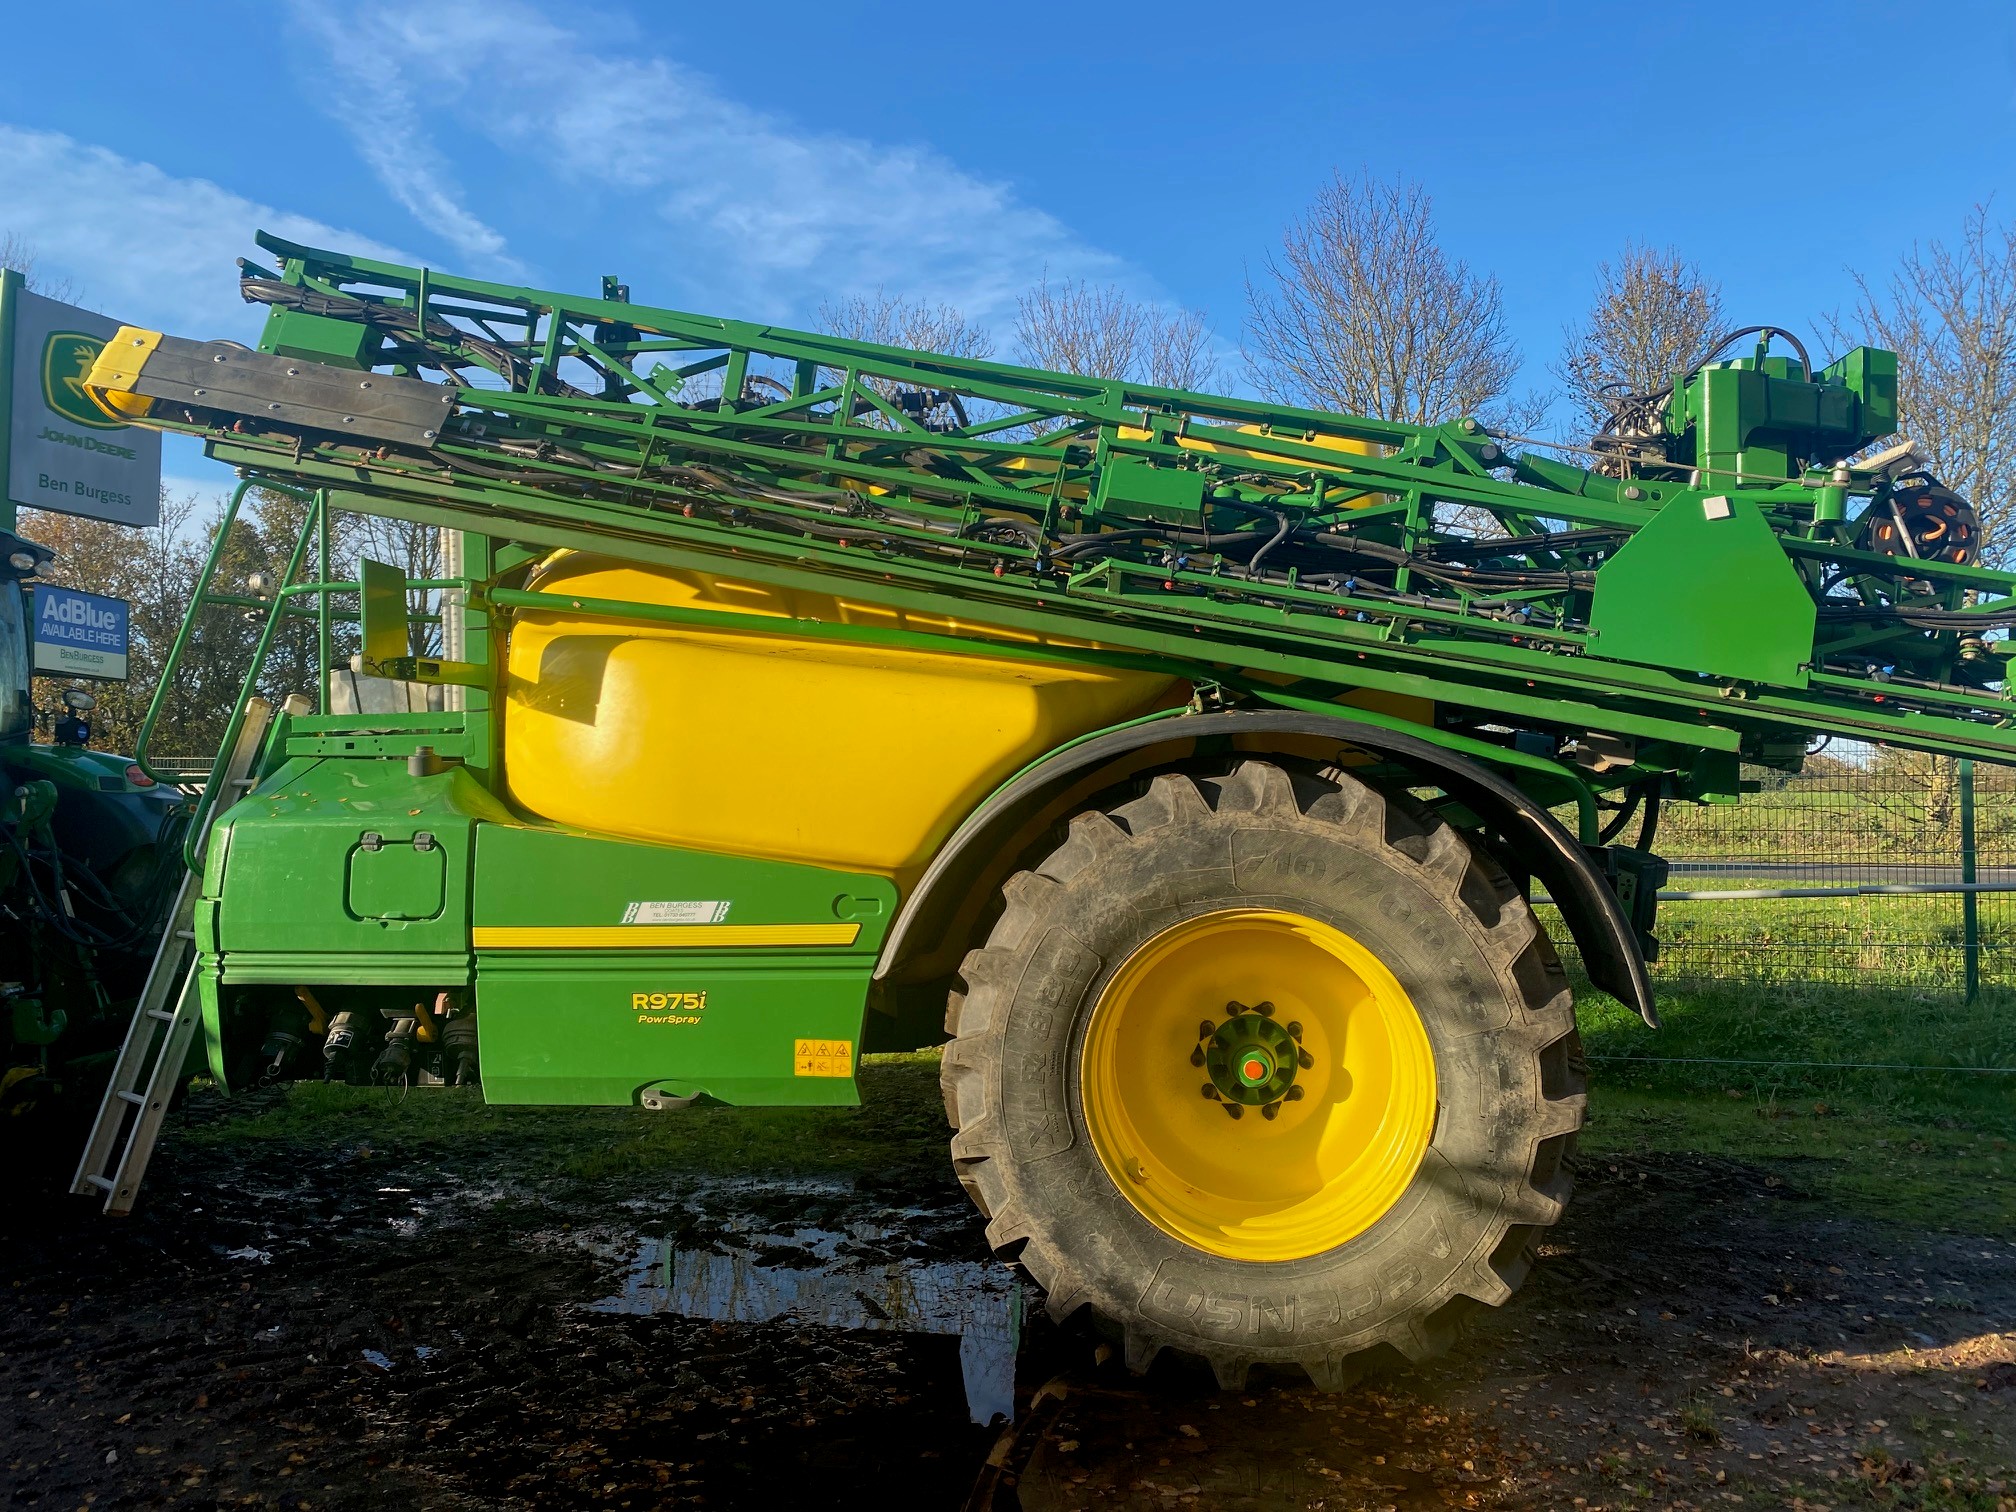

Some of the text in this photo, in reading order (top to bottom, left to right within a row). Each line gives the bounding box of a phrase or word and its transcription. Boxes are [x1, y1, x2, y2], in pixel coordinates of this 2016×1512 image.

[37, 426, 137, 461] JOHN DEERE
[38, 473, 132, 506] Ben Burgess
[41, 622, 121, 647] AVAILABLE HERE
[631, 990, 707, 1010] R975i
[638, 1014, 701, 1025] PowrSpray
[1150, 1210, 1453, 1335] ASCENSO
